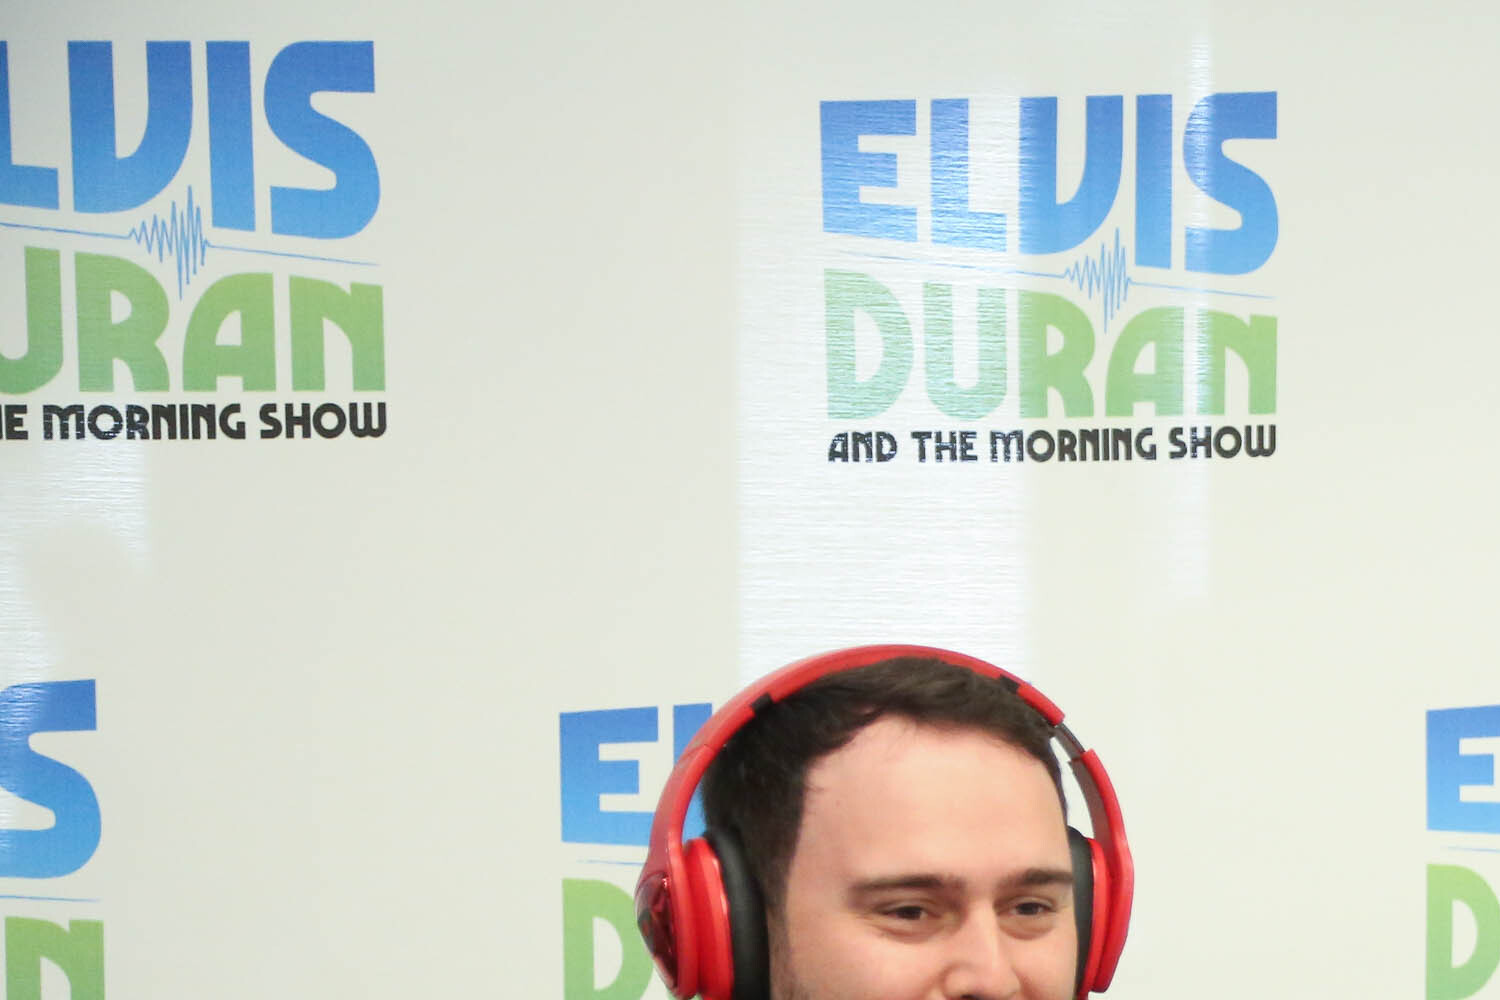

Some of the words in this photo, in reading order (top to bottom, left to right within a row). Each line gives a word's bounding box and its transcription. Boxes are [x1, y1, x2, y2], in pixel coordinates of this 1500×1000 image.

[0, 40, 380, 239] LVIS
[820, 91, 1279, 275] ELVIS
[0, 245, 386, 395] URAN
[824, 268, 1278, 421] DURAN
[43, 404, 246, 440] MORNING
[260, 402, 387, 439] SHOW
[828, 431, 897, 463] AND
[911, 431, 978, 463] THE
[990, 427, 1157, 463] MORNING
[1168, 424, 1277, 460] SHOW
